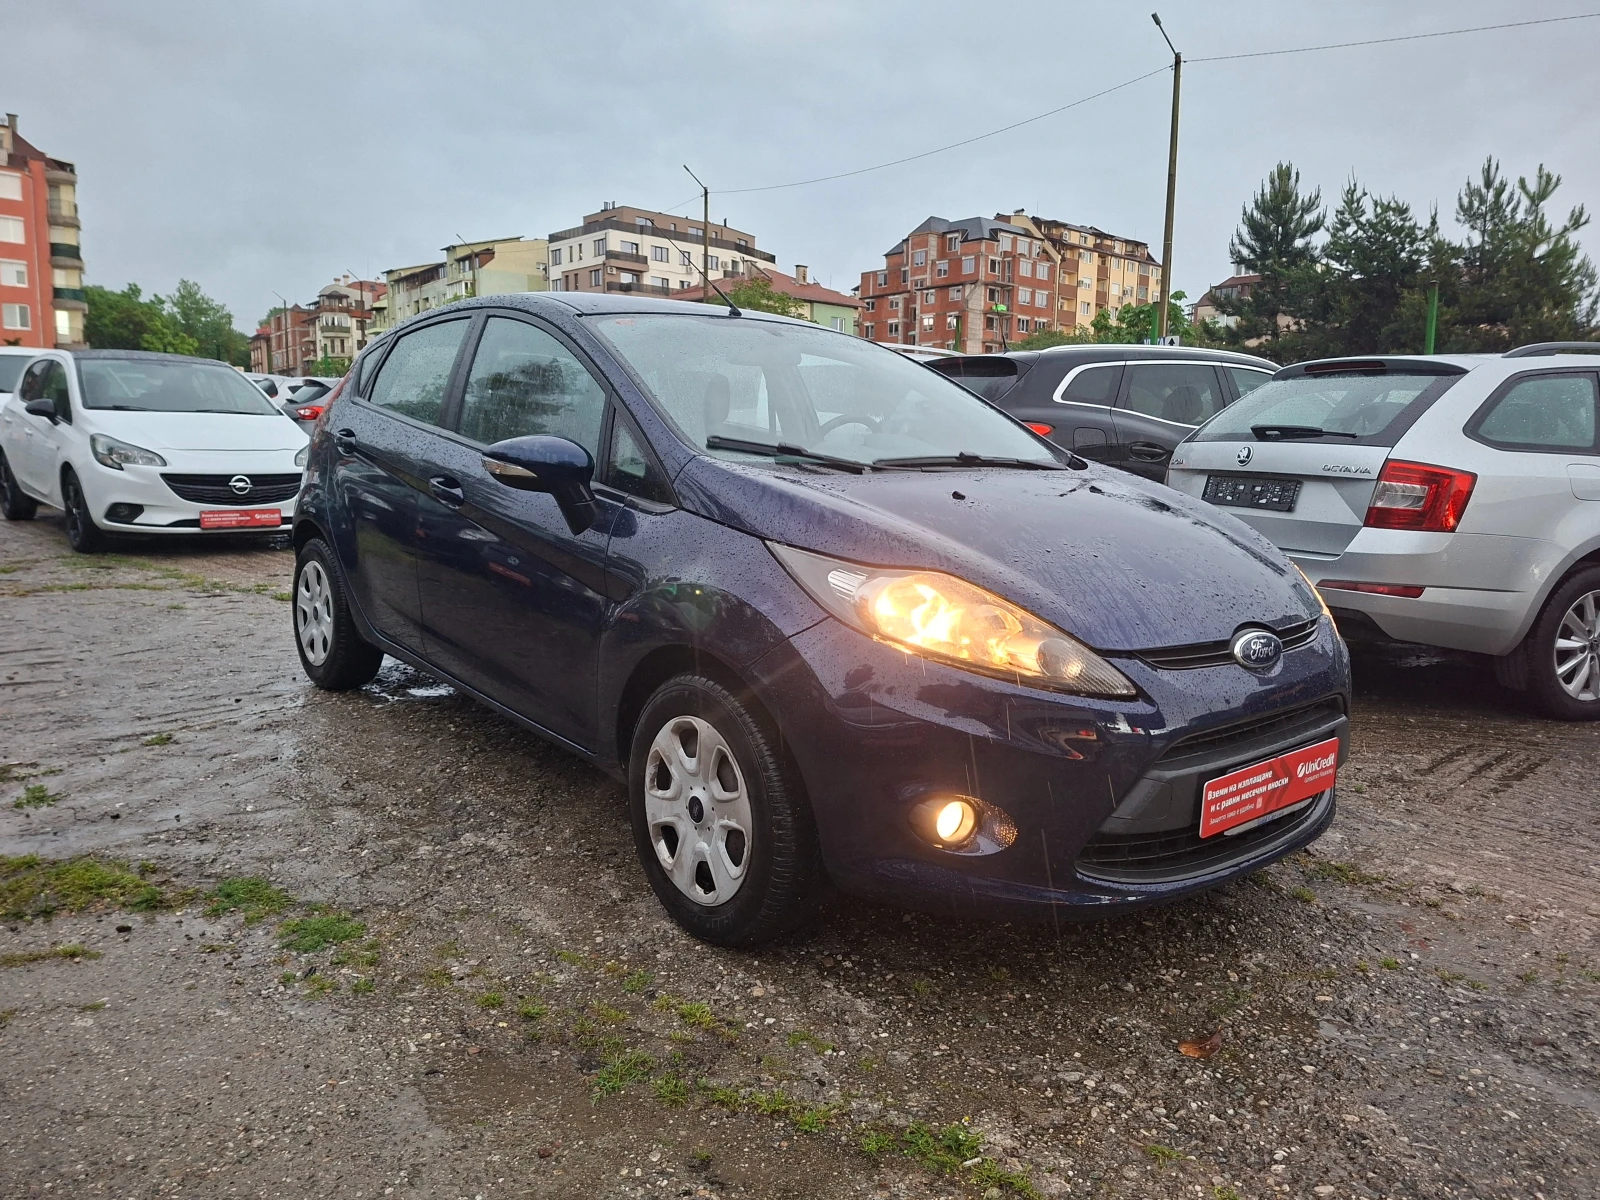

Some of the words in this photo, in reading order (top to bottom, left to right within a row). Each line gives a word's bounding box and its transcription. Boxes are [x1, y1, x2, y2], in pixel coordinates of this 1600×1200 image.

[1322, 464, 1371, 474] OCTAVIA
[1250, 638, 1275, 660] Ford
[1305, 752, 1334, 774] UniCredit
[1207, 787, 1228, 800] Вземи
[1228, 784, 1237, 793] на
[1237, 770, 1273, 790] изплащане
[1216, 802, 1221, 810] с
[1221, 796, 1241, 810] равни
[1241, 785, 1267, 800] месечни
[1267, 777, 1289, 791] вноски
[1209, 813, 1227, 825] Защото
